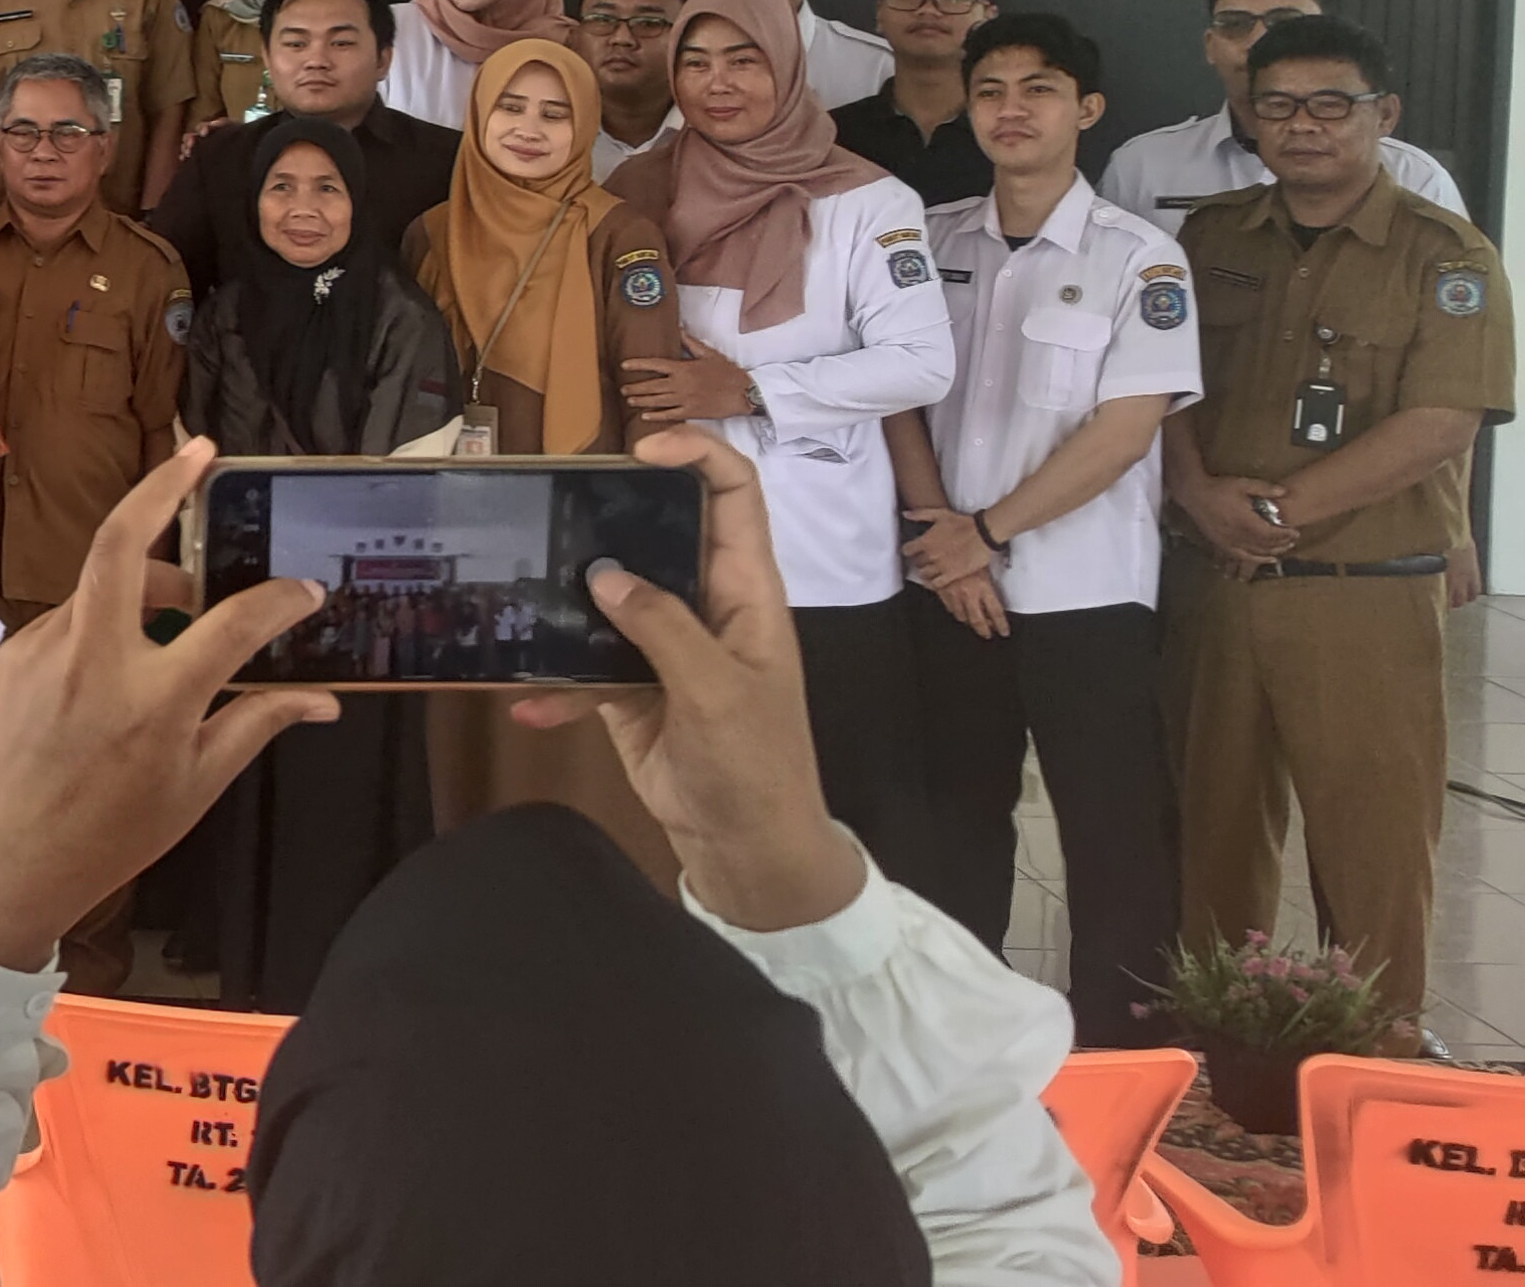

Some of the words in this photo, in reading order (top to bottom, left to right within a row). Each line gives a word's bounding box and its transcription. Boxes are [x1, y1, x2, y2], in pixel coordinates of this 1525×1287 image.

[106, 1059, 183, 1094] KEL.
[189, 1071, 258, 1104] BTG
[166, 1160, 217, 1190] TA.
[1408, 1138, 1497, 1175] KEL.
